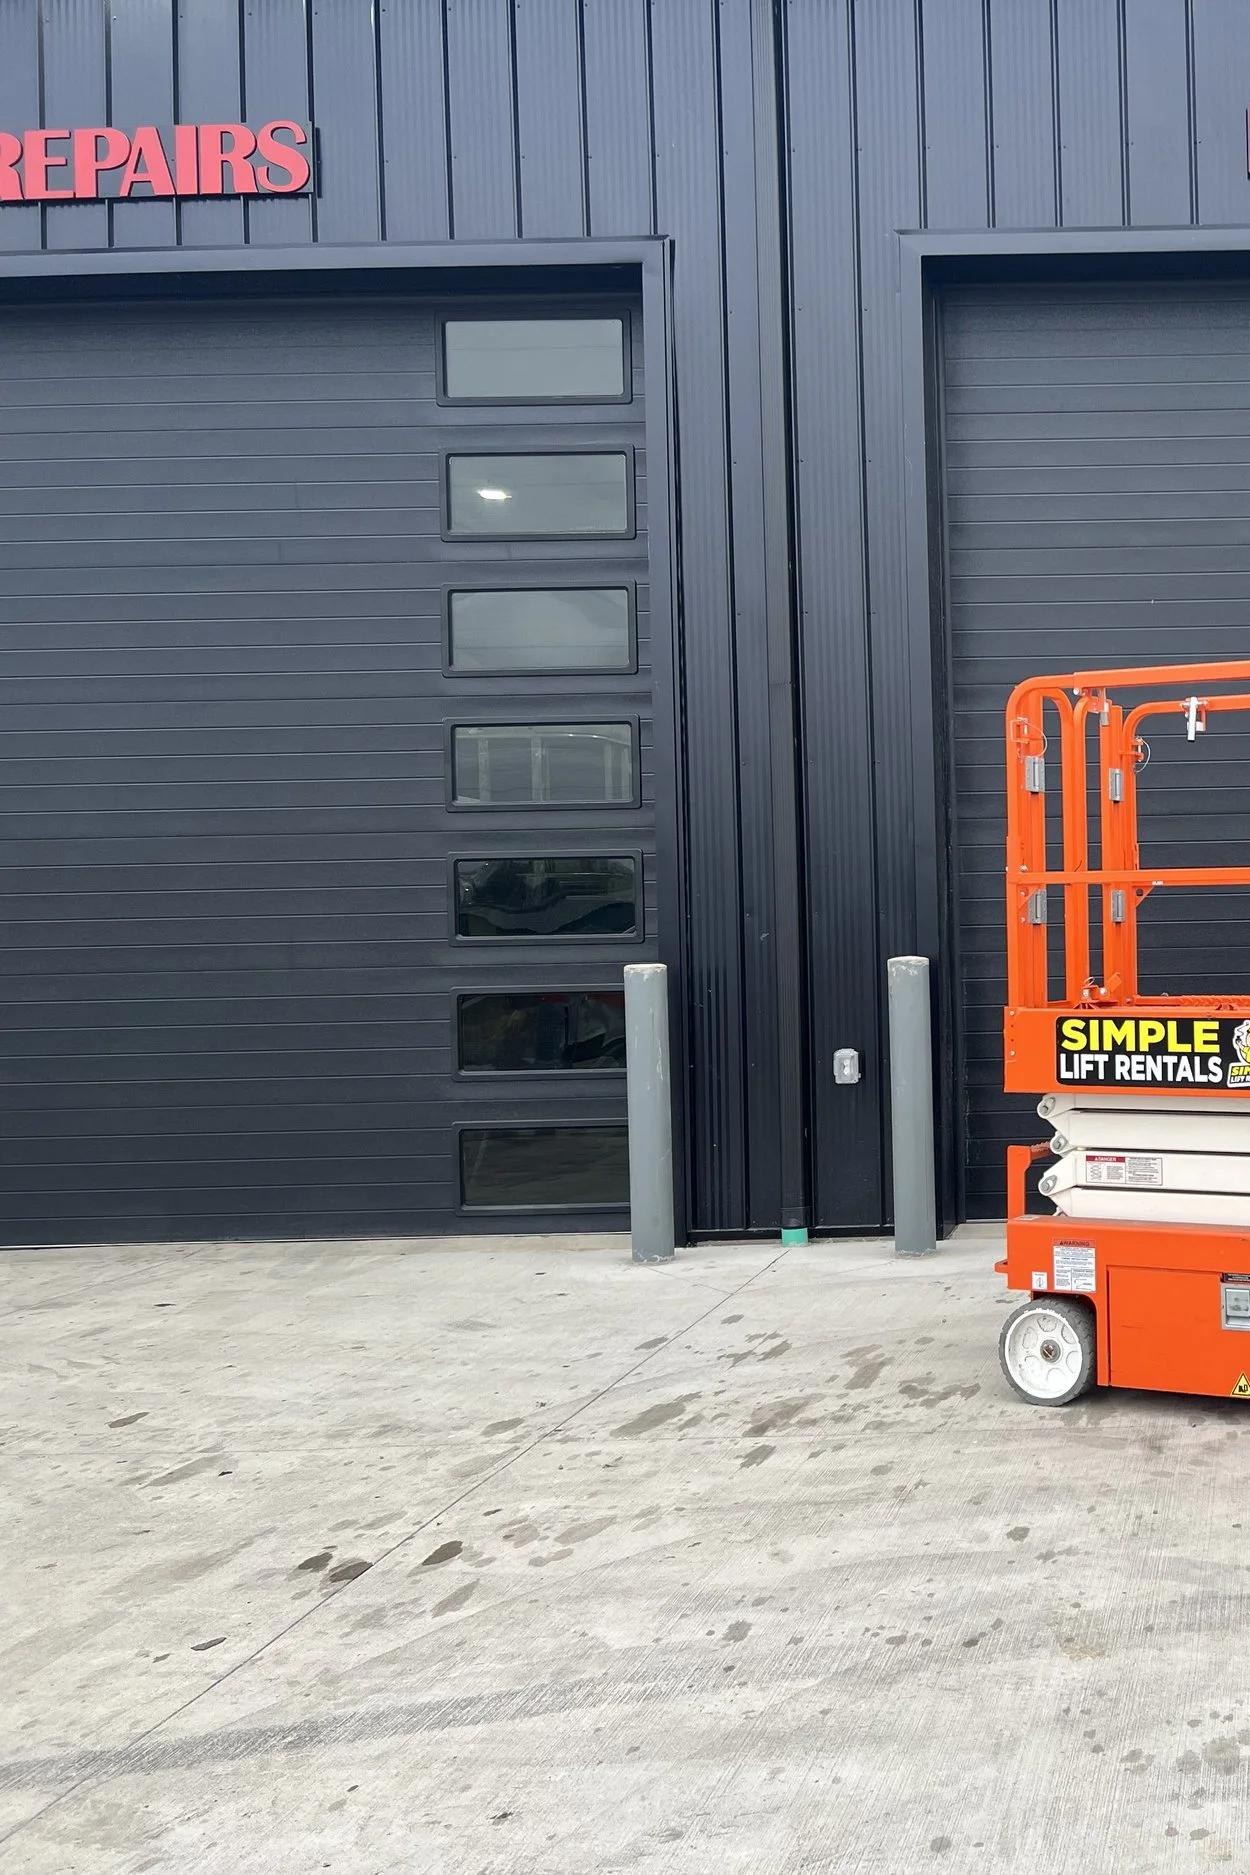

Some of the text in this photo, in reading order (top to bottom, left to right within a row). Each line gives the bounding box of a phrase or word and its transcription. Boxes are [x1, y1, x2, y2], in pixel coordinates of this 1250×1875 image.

[1060, 1018, 1221, 1054] SIMPLE
[1059, 1053, 1223, 1084] LIFT RENTALS
[1230, 1075, 1245, 1083] LIFT
